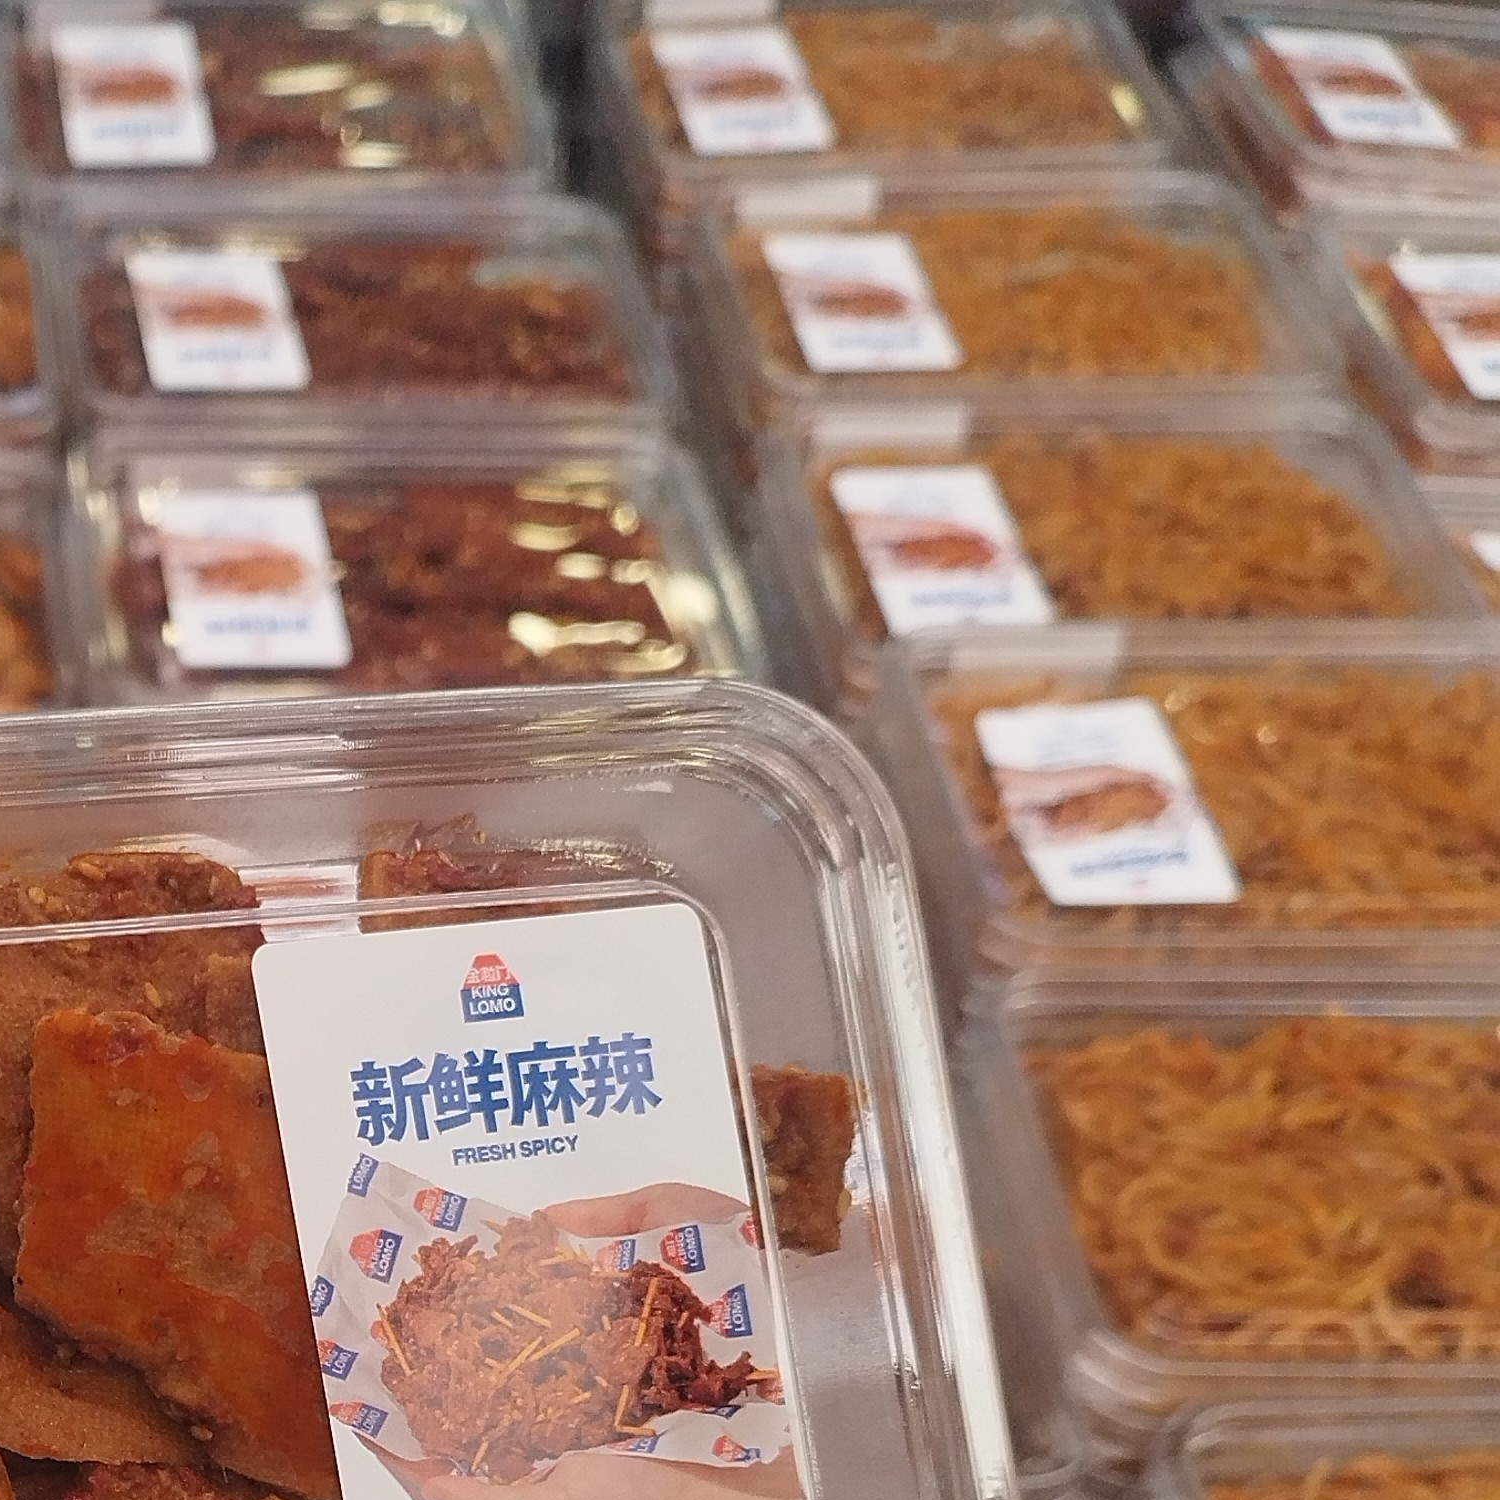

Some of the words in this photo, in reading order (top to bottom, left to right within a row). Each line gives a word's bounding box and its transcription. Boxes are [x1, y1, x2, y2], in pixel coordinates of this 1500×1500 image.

[468, 997, 516, 1016] LOMO
[471, 982, 510, 1000] KING
[350, 1032, 664, 1147] 新鲜麻辣
[452, 1142, 517, 1167] FRESH
[520, 1134, 579, 1159] SPICY
[377, 1237, 396, 1277] LOMO
[683, 1227, 699, 1268] LOMO
